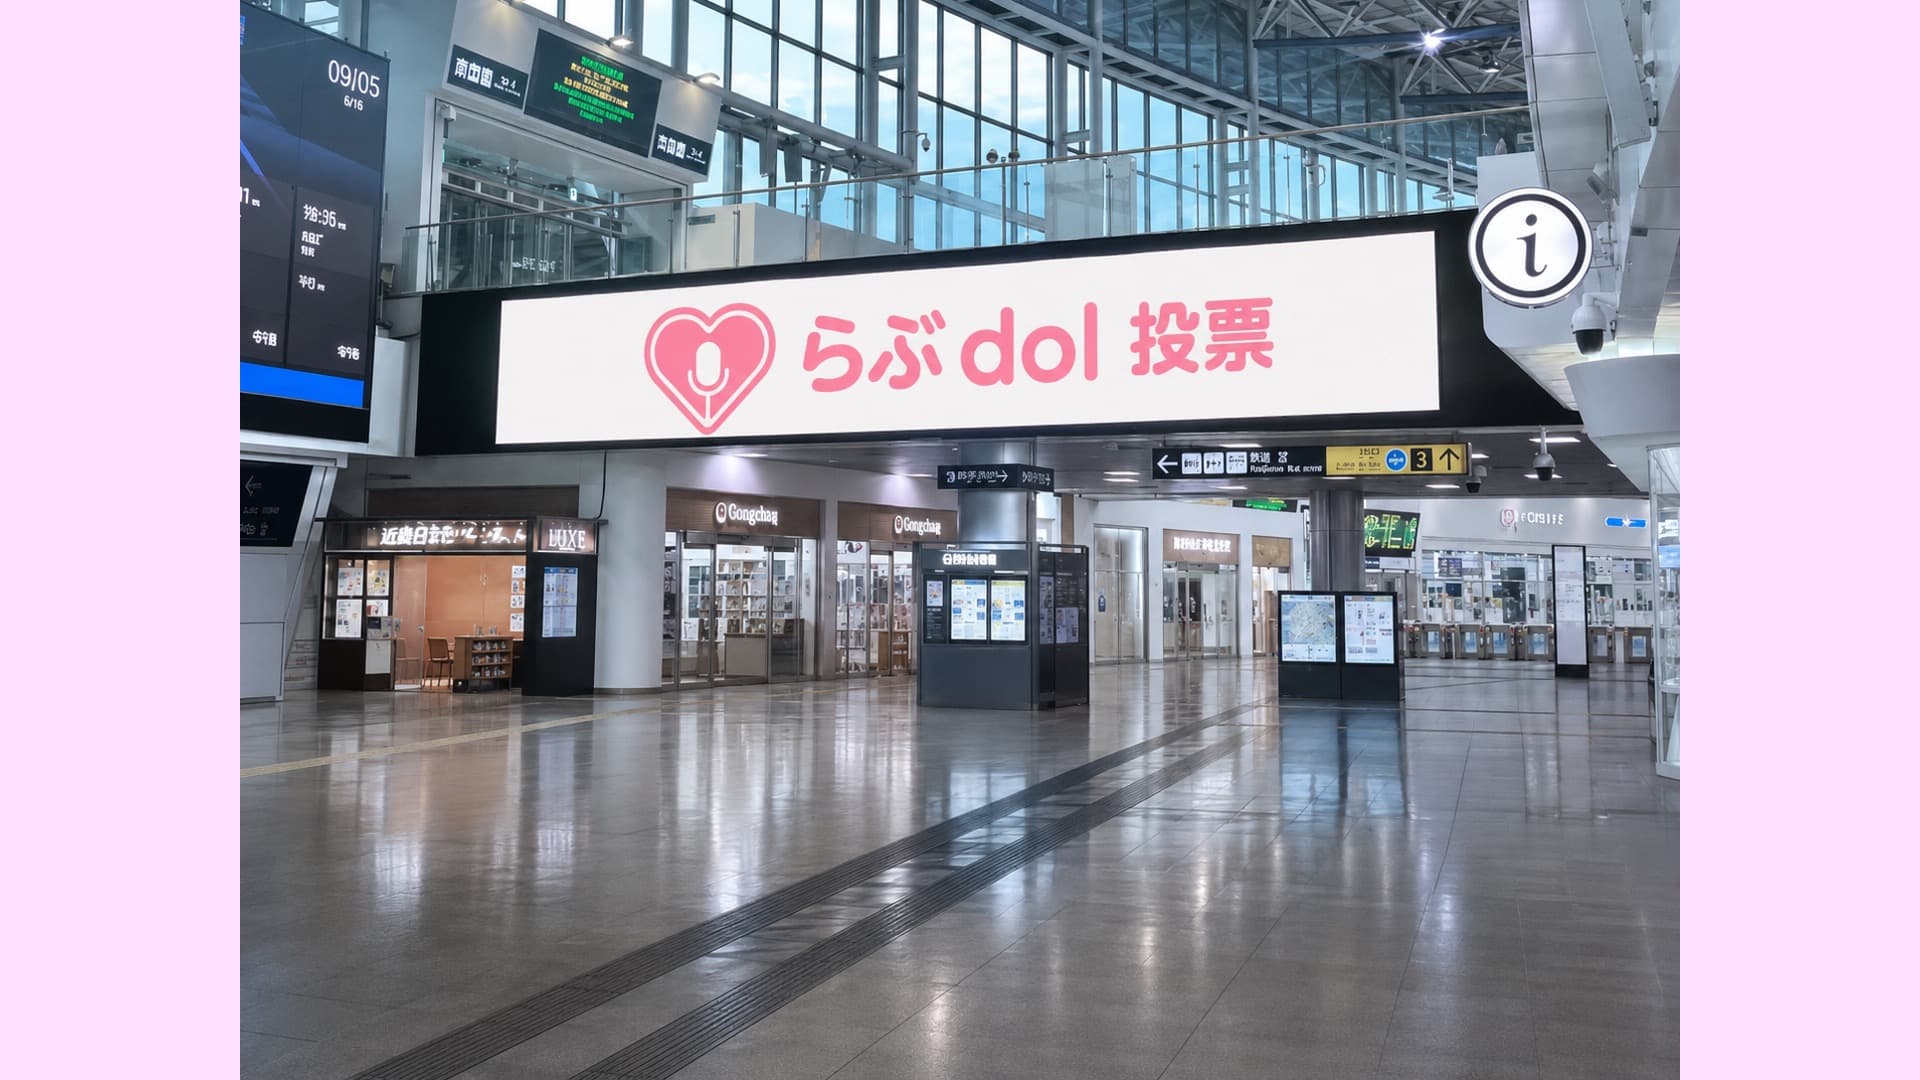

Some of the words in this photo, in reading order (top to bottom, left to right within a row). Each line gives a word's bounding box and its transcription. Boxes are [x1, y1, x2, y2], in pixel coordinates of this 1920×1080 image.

[328, 59, 380, 98] 09/05
[343, 95, 364, 111] 6/16
[803, 309, 946, 393] らぶ
[960, 301, 1098, 387] dol
[1129, 297, 1274, 376] 投票
[1416, 450, 1428, 468] 3
[548, 528, 586, 549] LUXE
